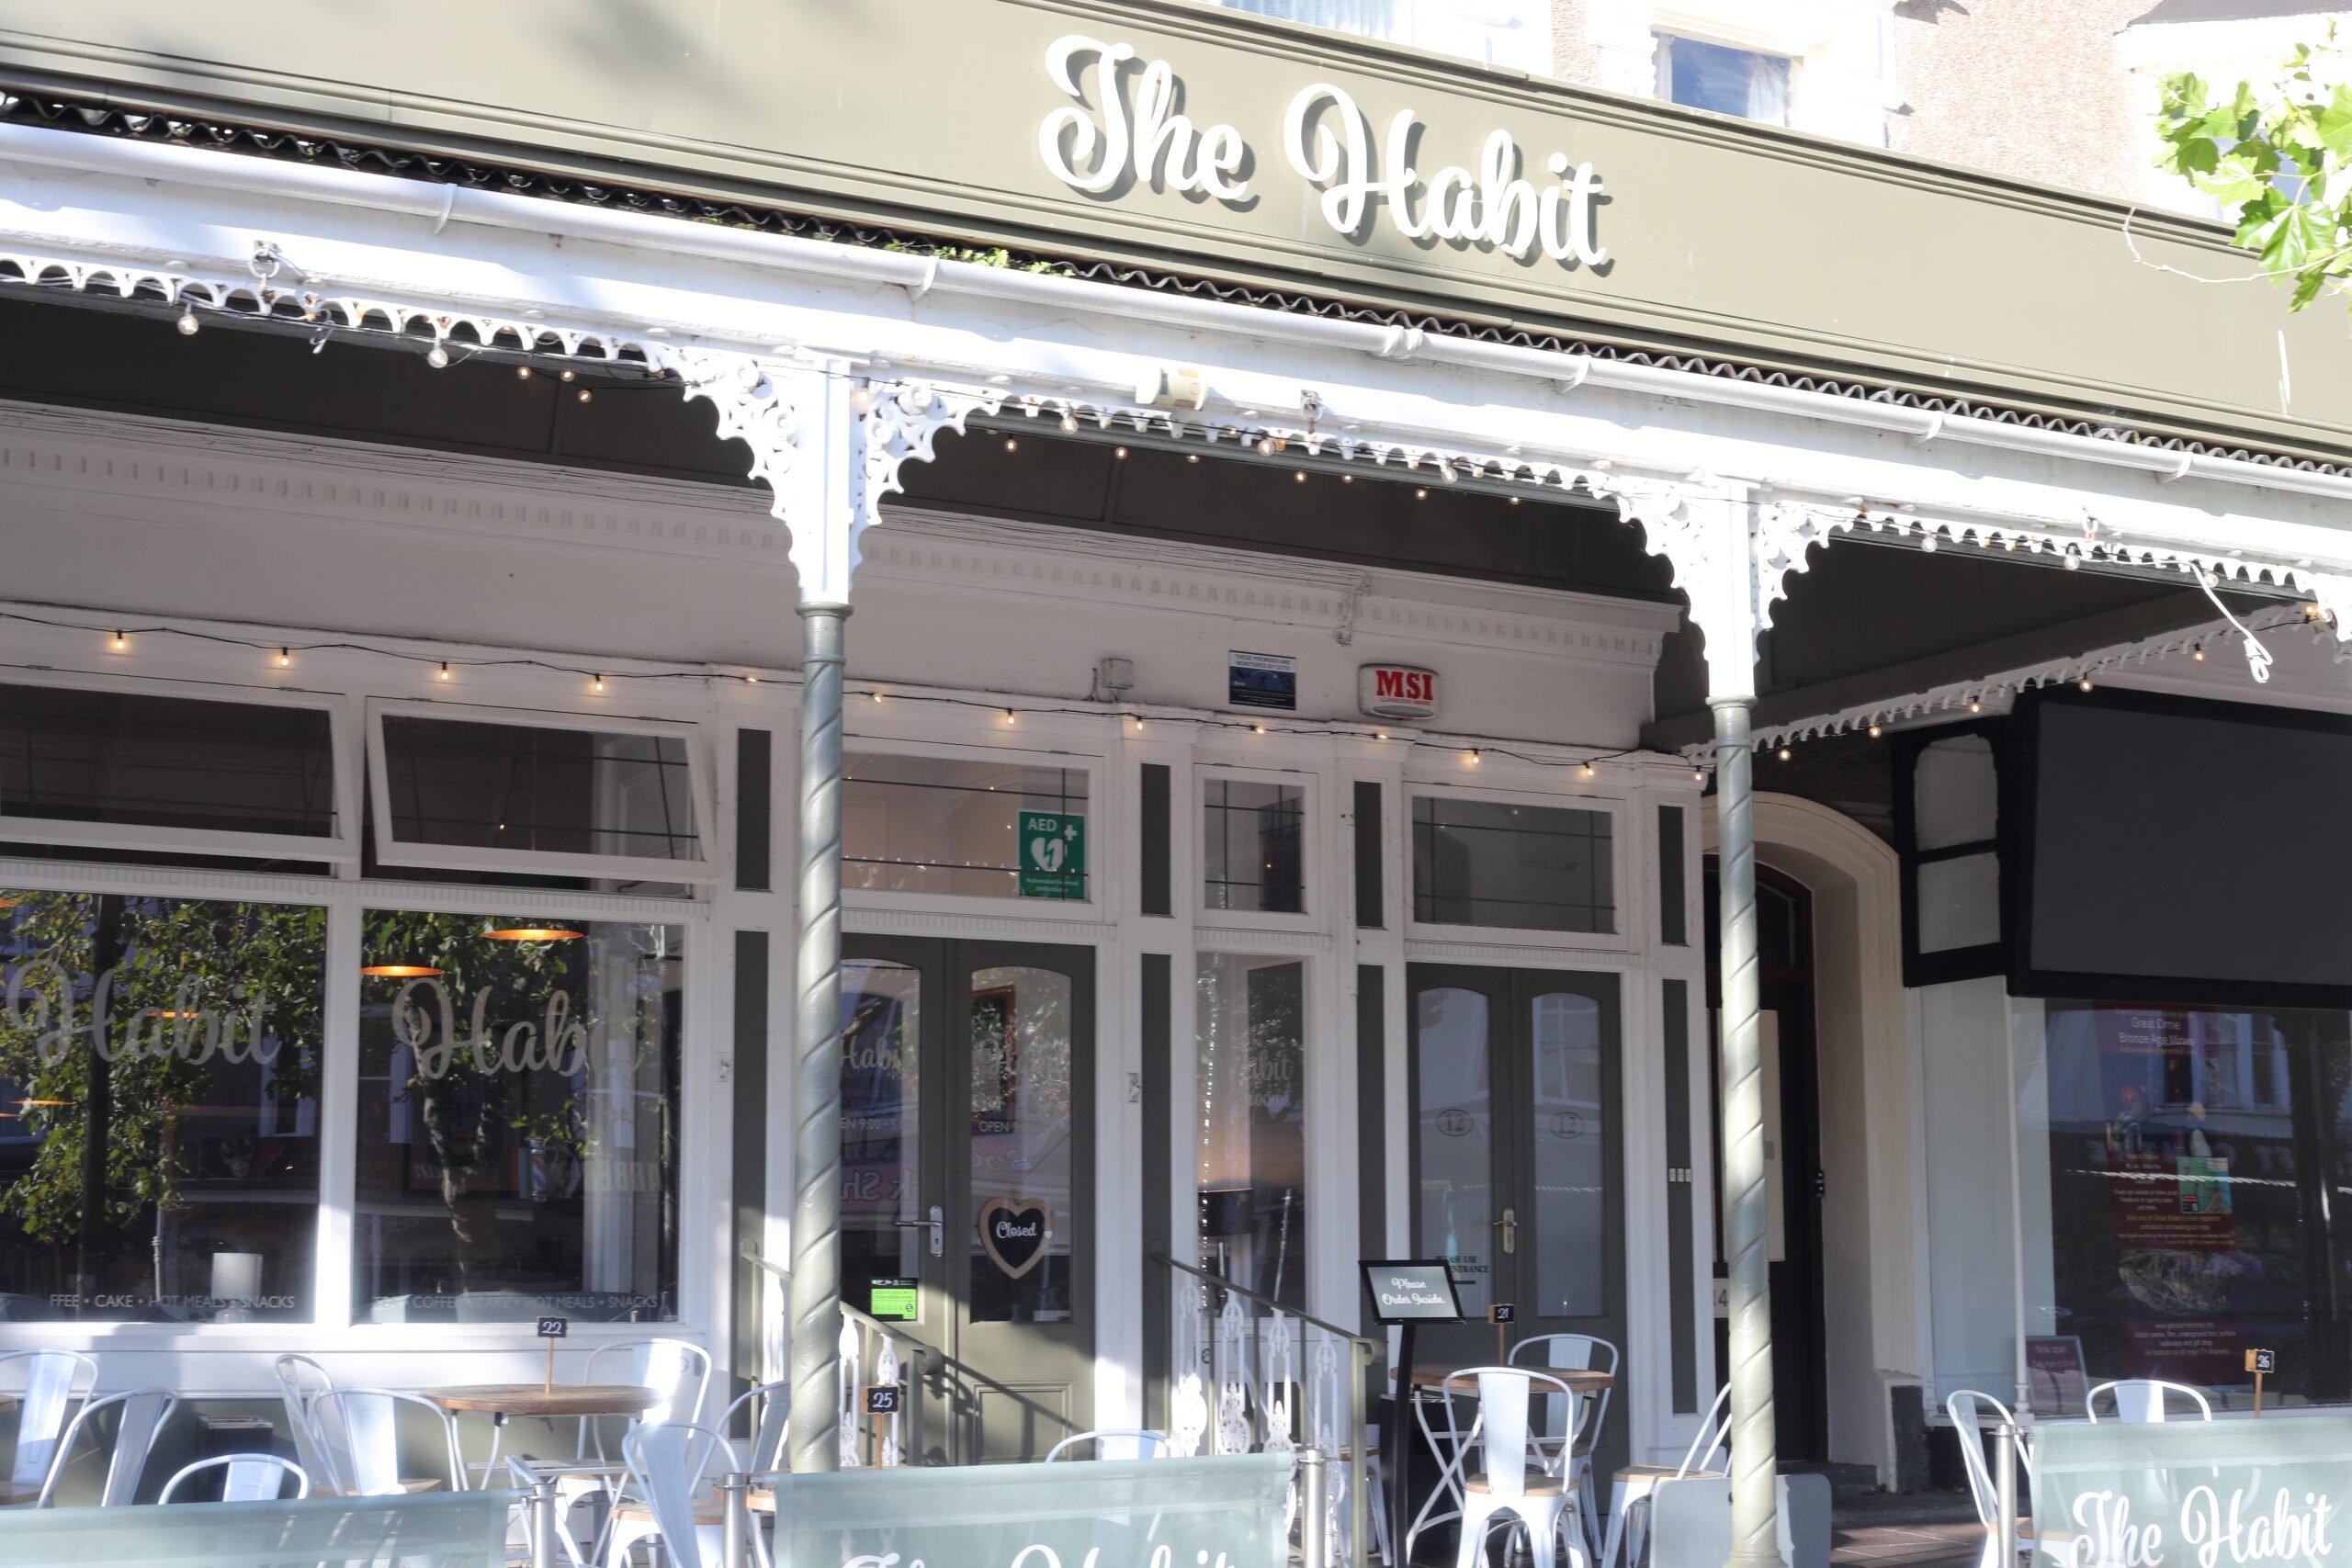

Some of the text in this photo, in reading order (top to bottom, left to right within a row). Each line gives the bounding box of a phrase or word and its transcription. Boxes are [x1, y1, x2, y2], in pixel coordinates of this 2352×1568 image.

[1039, 35, 1607, 265] The Habit
[1375, 670, 1433, 701] MSI
[1027, 818, 1057, 832] AED
[6, 959, 282, 1066] Habit
[979, 1121, 1010, 1133] OPEN
[996, 1221, 1036, 1238] Closed
[95, 1294, 134, 1308] CAKE
[148, 1294, 181, 1308] HOT
[186, 1294, 227, 1309] MEALS
[240, 1295, 296, 1309] SNACKS
[414, 1295, 462, 1309] COFFE
[556, 1296, 596, 1309] MEALS
[608, 1296, 659, 1309] SNACKS
[541, 1321, 562, 1335] 22
[872, 1392, 893, 1408] 25
[2068, 1484, 2334, 1568] The Habit
